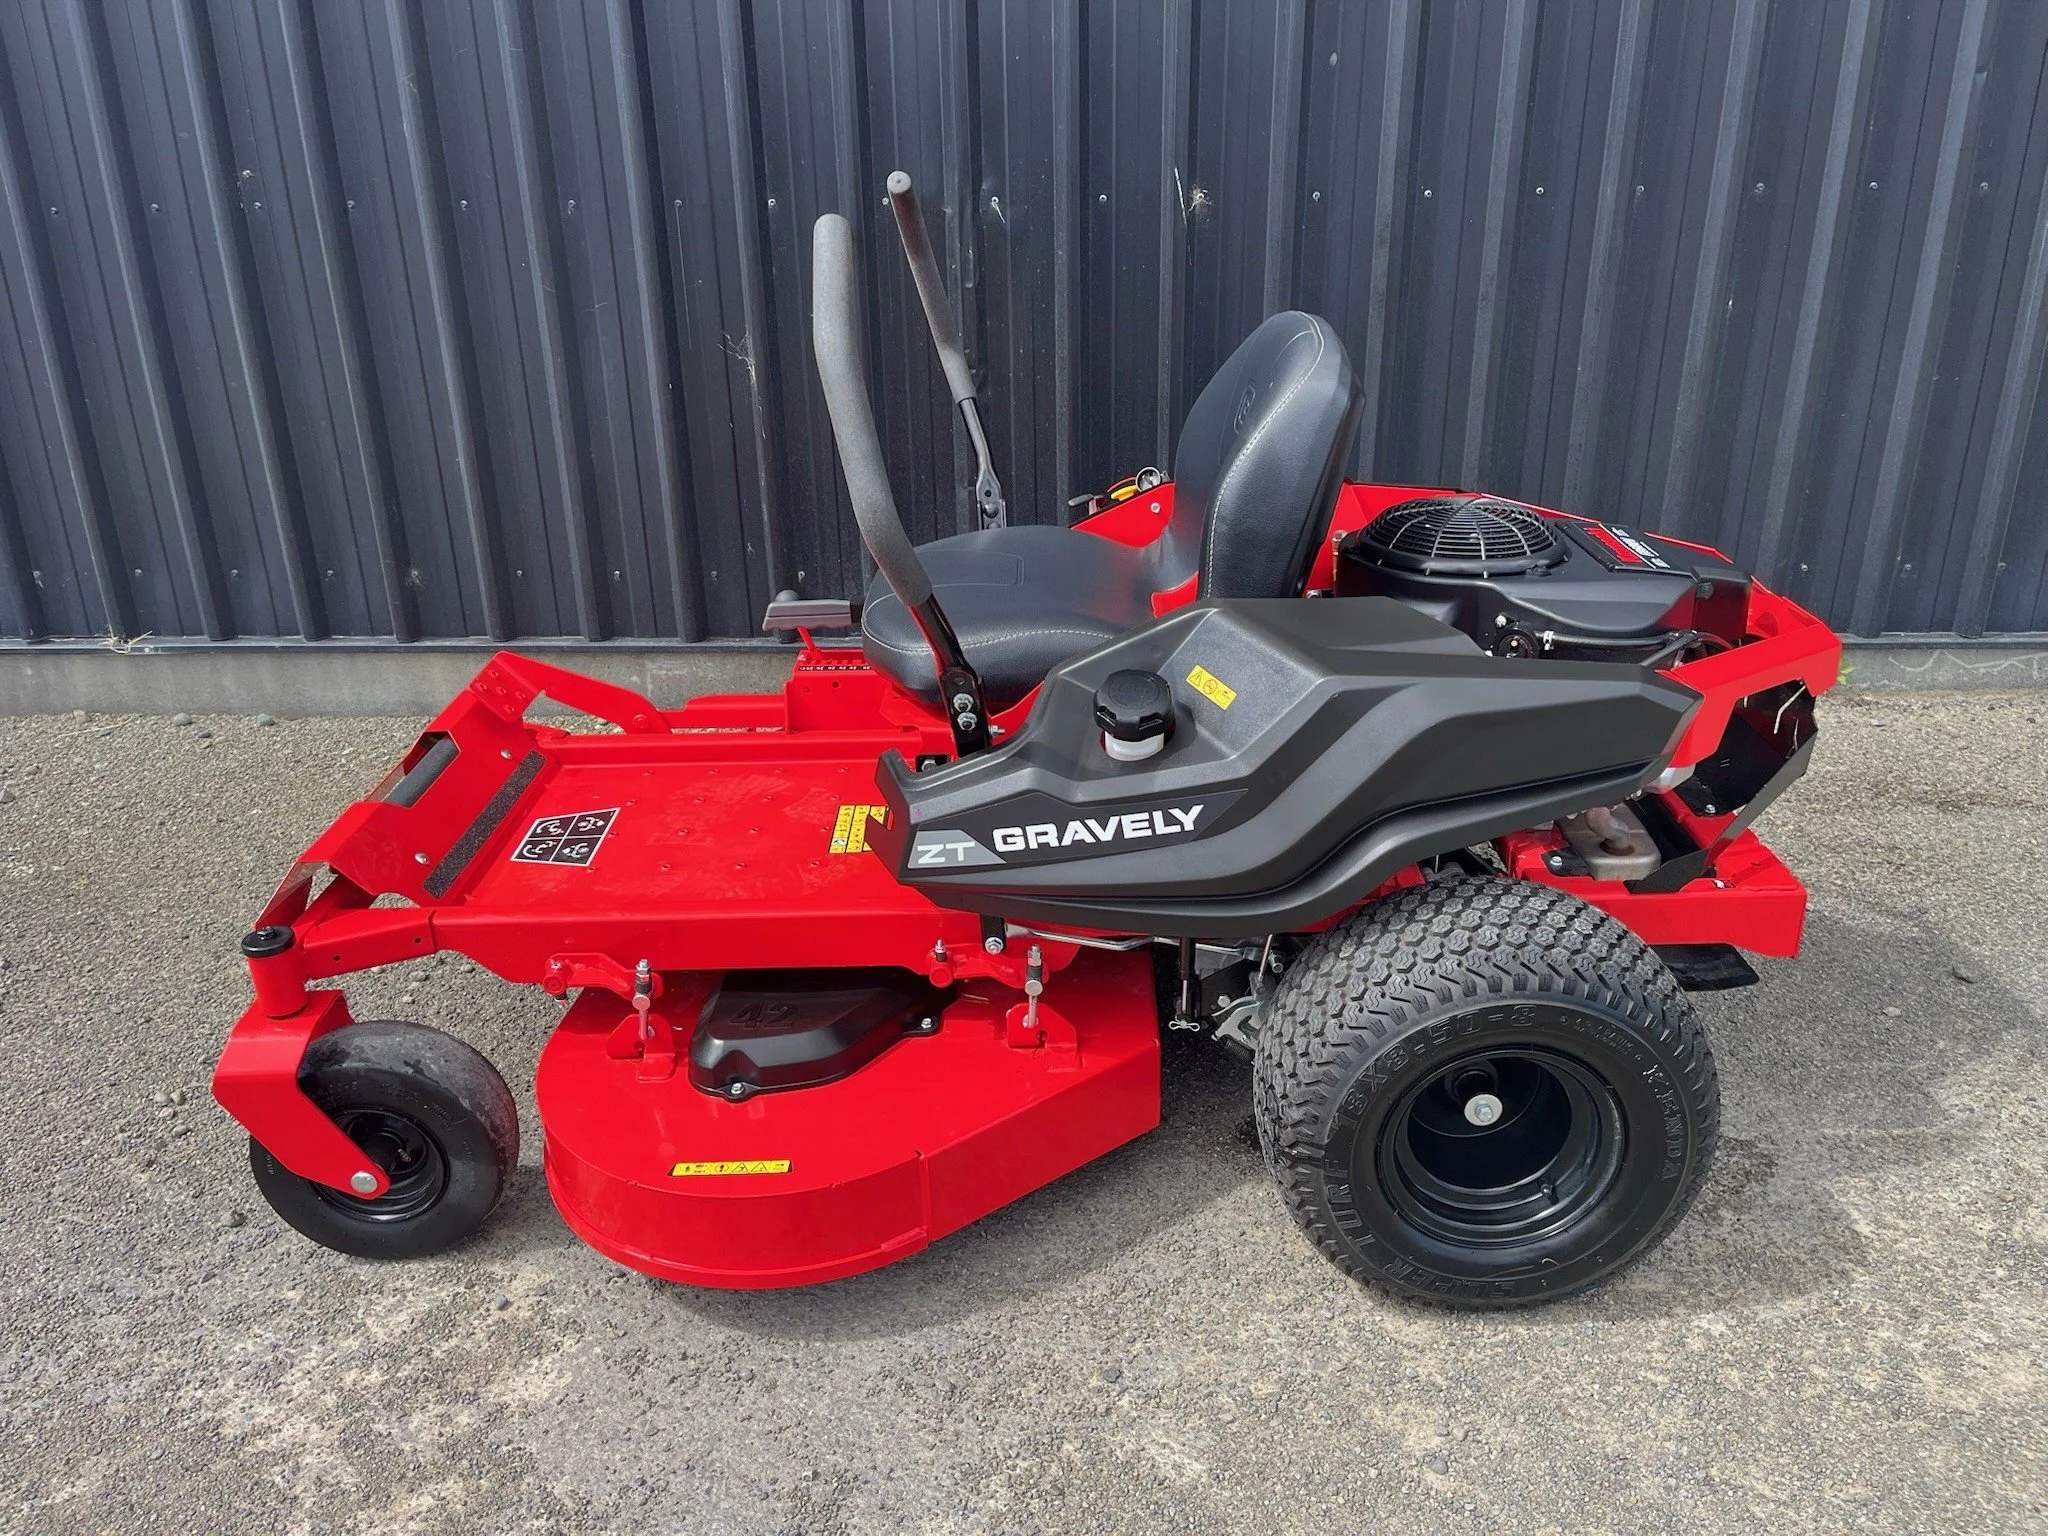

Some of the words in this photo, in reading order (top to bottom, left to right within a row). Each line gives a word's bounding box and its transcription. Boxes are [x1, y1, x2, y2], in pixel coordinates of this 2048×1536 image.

[917, 842, 976, 864] ZT
[992, 804, 1204, 853] GRAVELY
[730, 1002, 799, 1030] 42
[1643, 1064, 1684, 1181] KENDA
[1324, 1159, 1376, 1250] TURF
[1383, 1257, 1516, 1299] SUPER
